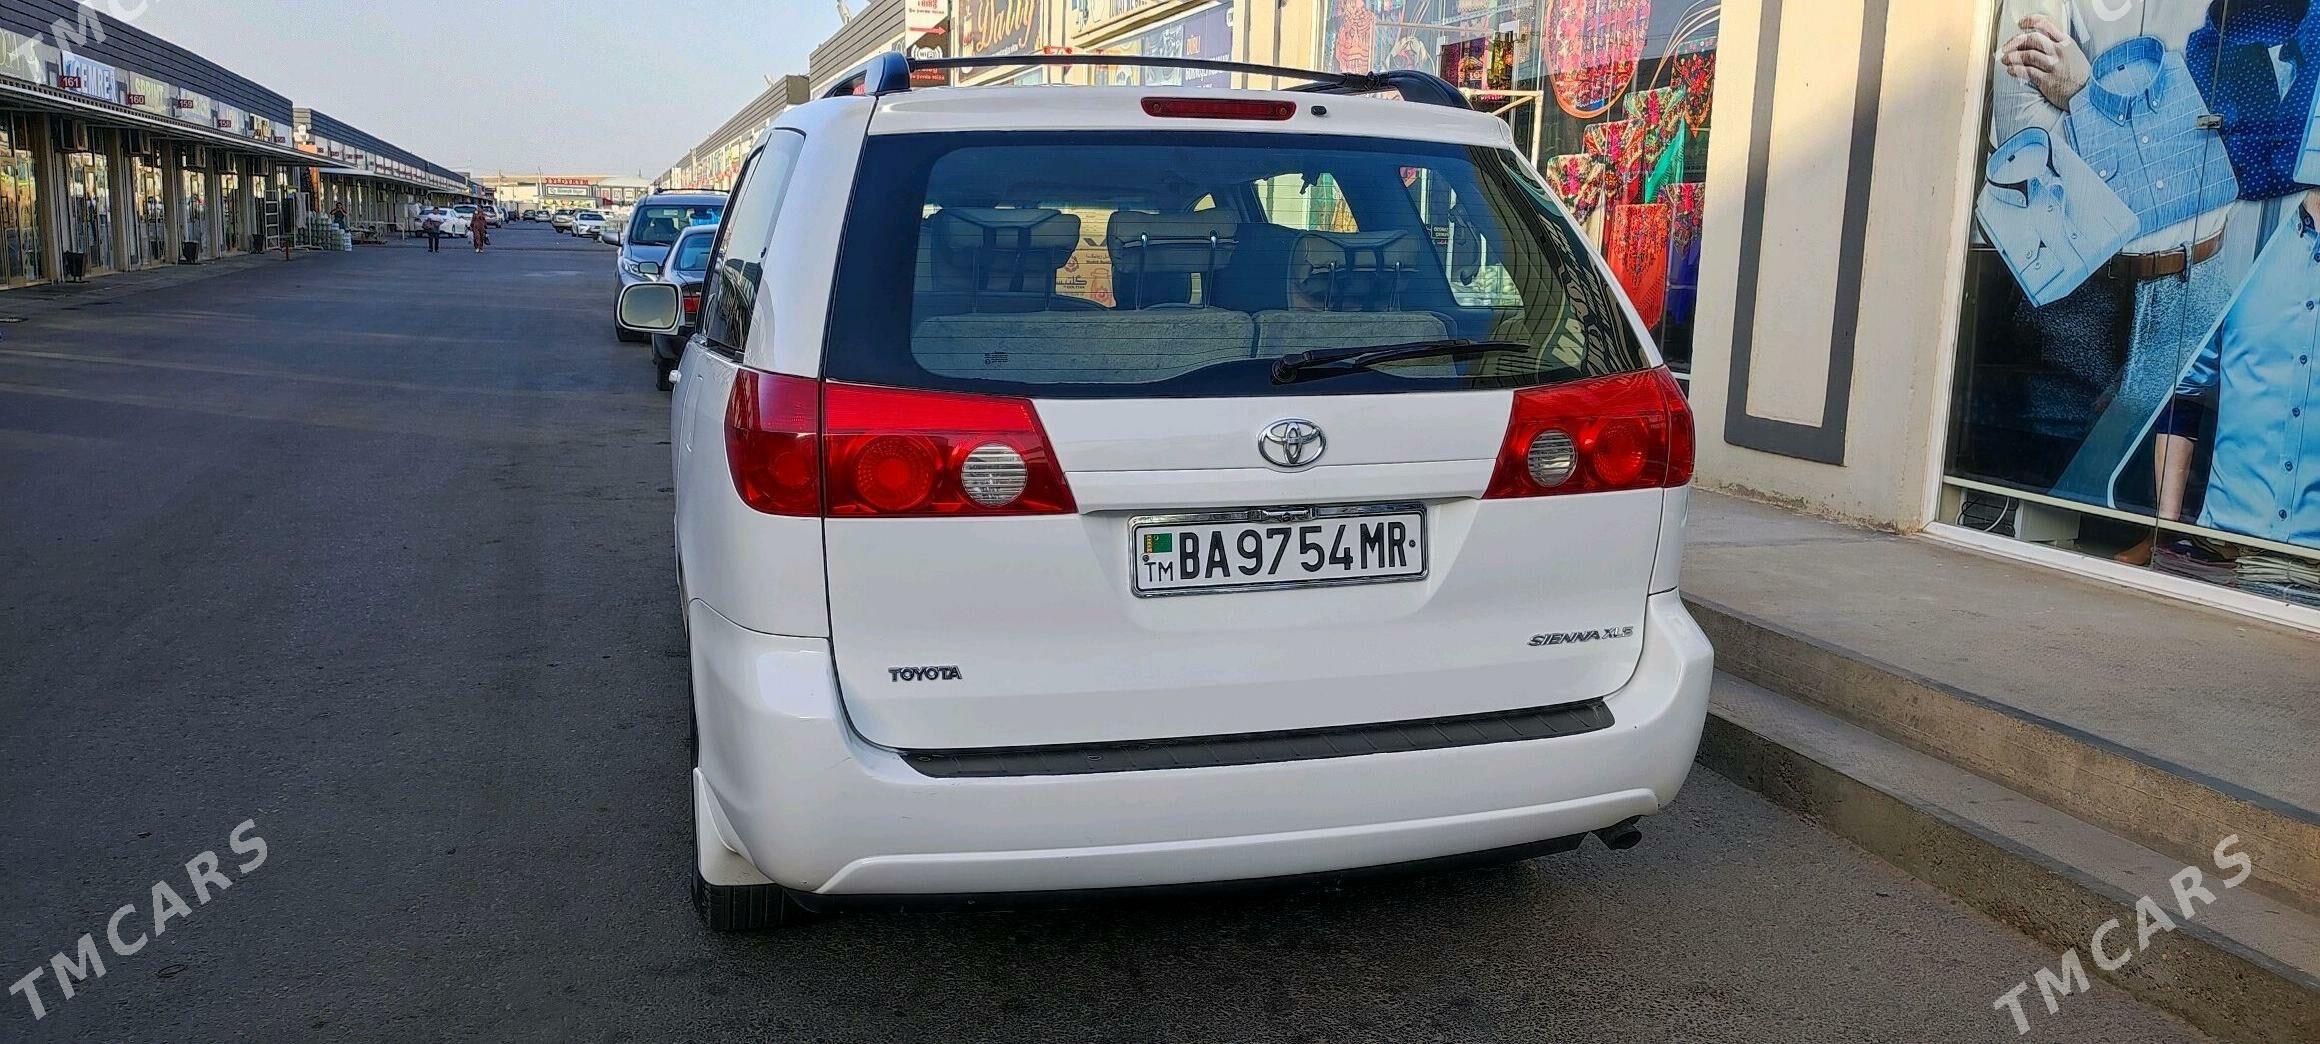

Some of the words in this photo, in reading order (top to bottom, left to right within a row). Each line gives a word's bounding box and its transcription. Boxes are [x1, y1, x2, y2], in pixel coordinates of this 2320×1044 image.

[62, 76, 80, 88] 161
[129, 95, 145, 104] 160
[179, 99, 193, 108] 159
[1179, 521, 1408, 580] BA9754MR
[1144, 561, 1174, 582] TM
[1527, 630, 1600, 647] SIENNA
[887, 665, 963, 683] TOYOTA
